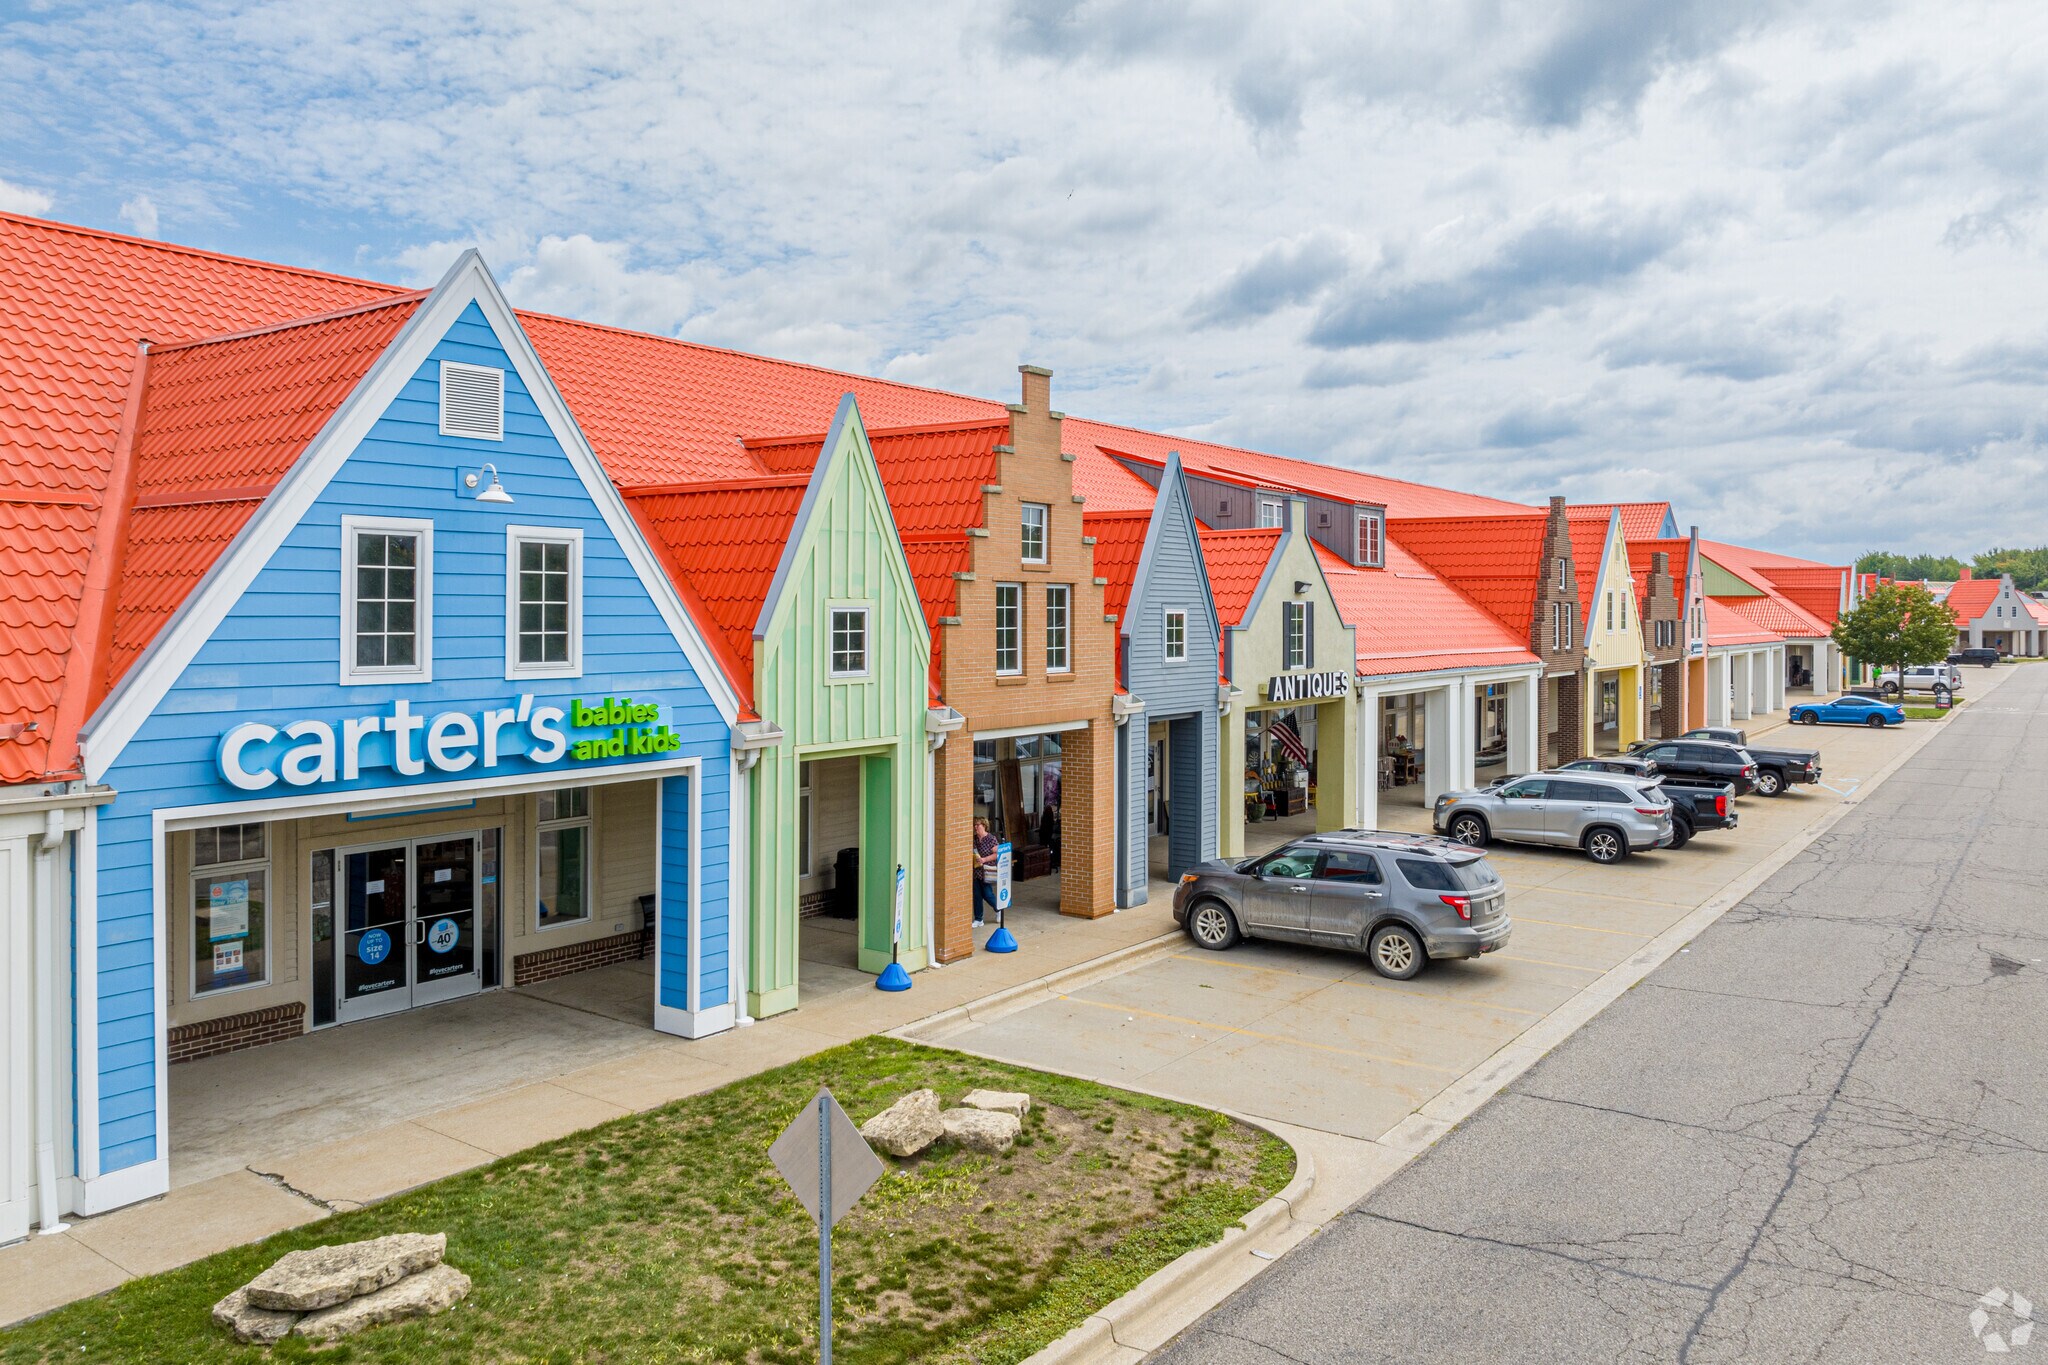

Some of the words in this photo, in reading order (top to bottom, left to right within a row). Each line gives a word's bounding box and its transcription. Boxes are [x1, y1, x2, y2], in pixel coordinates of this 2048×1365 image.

[1273, 672, 1349, 701] ANTIQUES
[571, 697, 659, 727] babies
[217, 694, 566, 791] carter's
[571, 728, 625, 760] and
[627, 725, 681, 755] kids
[366, 944, 383, 953] size
[370, 952, 380, 960] 14
